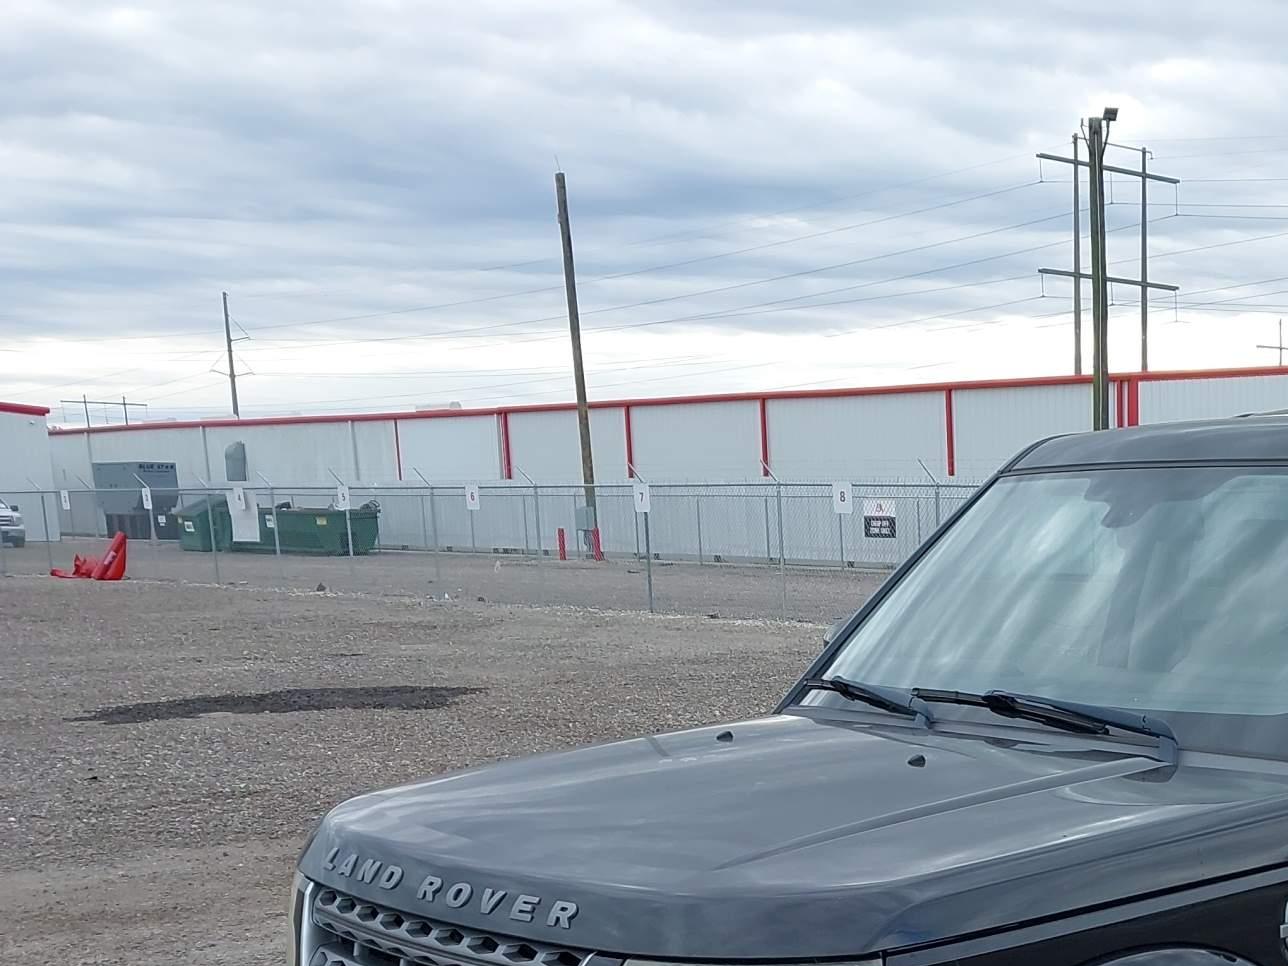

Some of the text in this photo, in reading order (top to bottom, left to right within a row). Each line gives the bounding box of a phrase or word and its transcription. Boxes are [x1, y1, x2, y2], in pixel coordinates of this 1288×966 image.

[470, 491, 475, 501] 6
[639, 492, 644, 503] 7
[839, 491, 846, 502] 8
[323, 848, 579, 929] LAND ROVER
